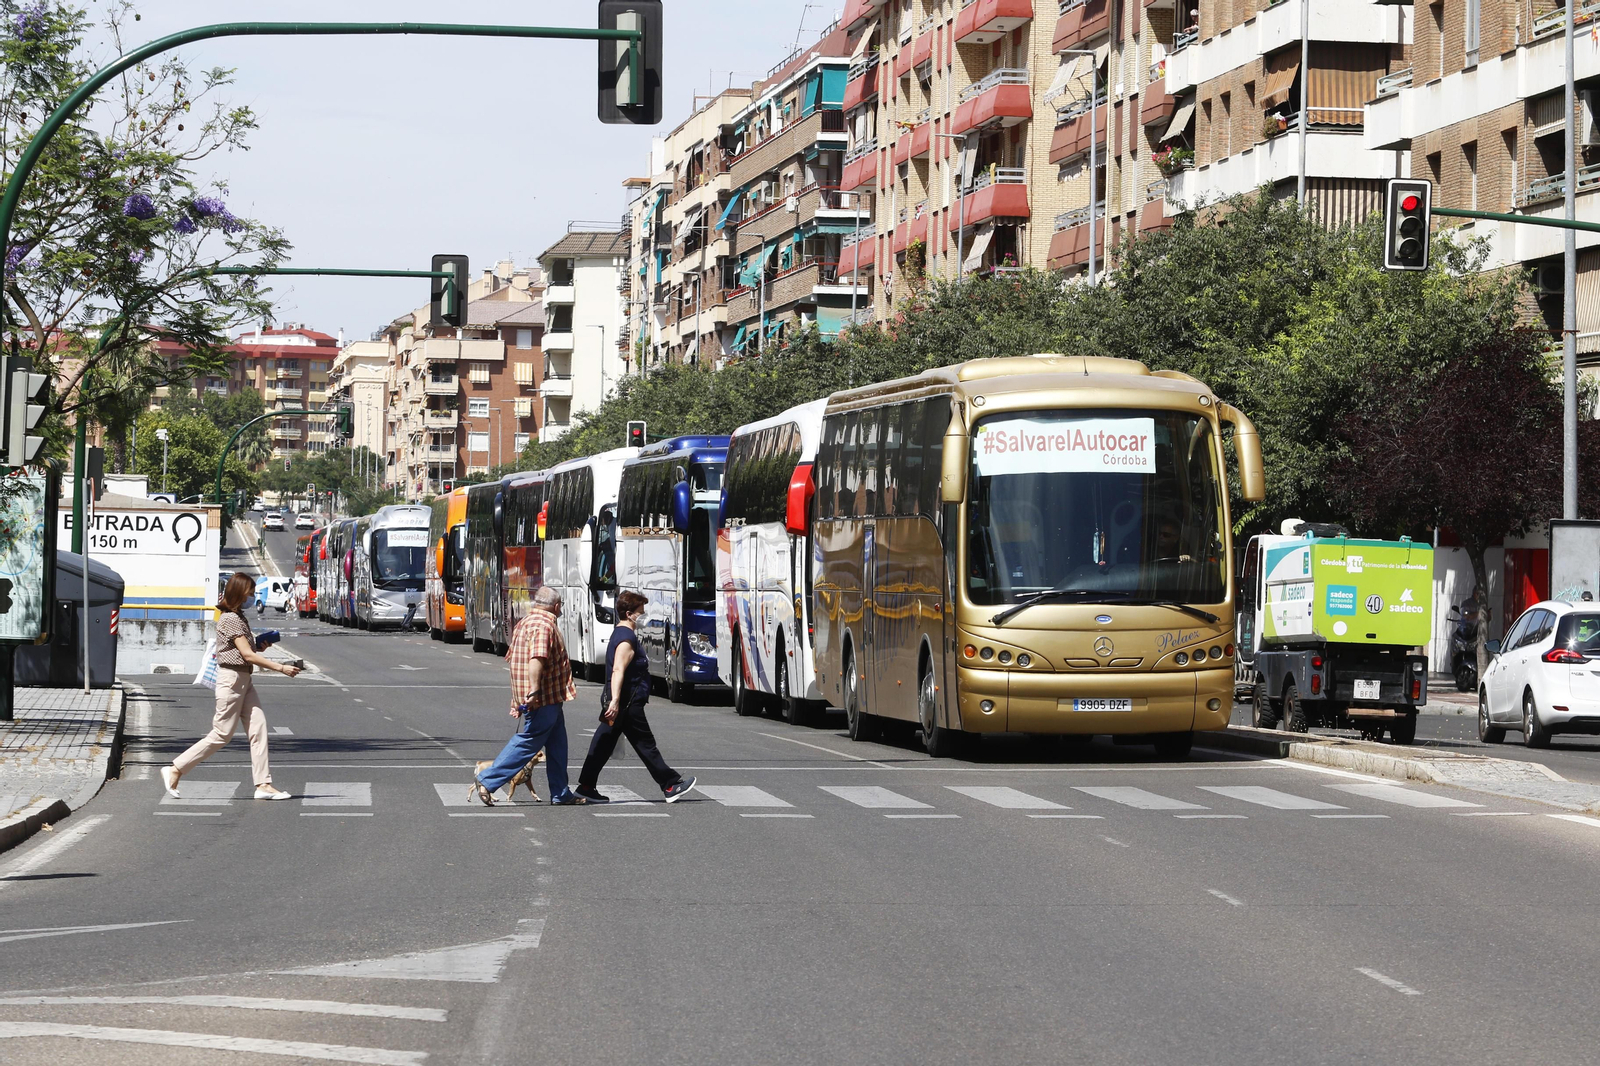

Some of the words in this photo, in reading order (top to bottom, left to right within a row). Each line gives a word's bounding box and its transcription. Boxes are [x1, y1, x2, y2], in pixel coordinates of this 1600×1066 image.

[983, 429, 1147, 454] #SalvarelAutocar
[1102, 453, 1147, 465] Córdoba
[90, 535, 118, 548] 150
[123, 538, 138, 548] m
[1330, 590, 1354, 598] sadeco
[1367, 596, 1381, 611] 40
[1389, 603, 1424, 613] sadeco
[1155, 630, 1200, 653] Pelaez
[1080, 700, 1106, 710] 9905
[1109, 700, 1129, 710] DZF
